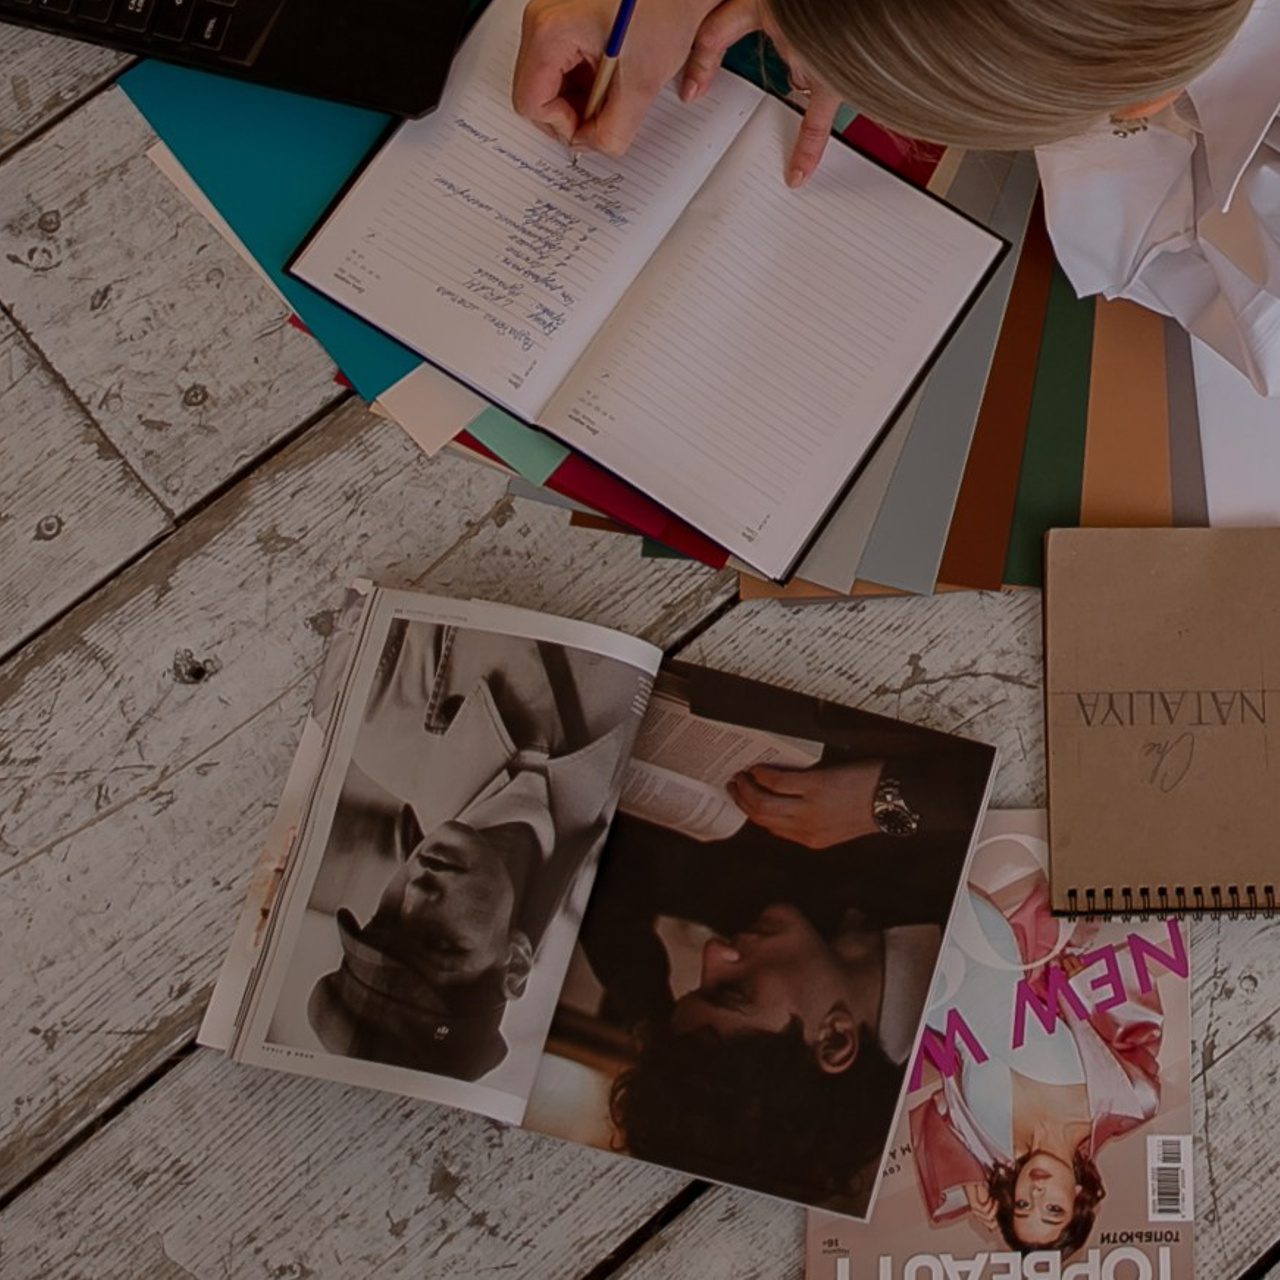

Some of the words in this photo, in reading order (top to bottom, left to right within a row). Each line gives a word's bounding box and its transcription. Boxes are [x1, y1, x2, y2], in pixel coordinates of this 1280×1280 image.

[1077, 690, 1266, 727] NATALIYA
[1012, 917, 1190, 1050] NEW
[1101, 1229, 1181, 1244] ТОПБЬЮТИ
